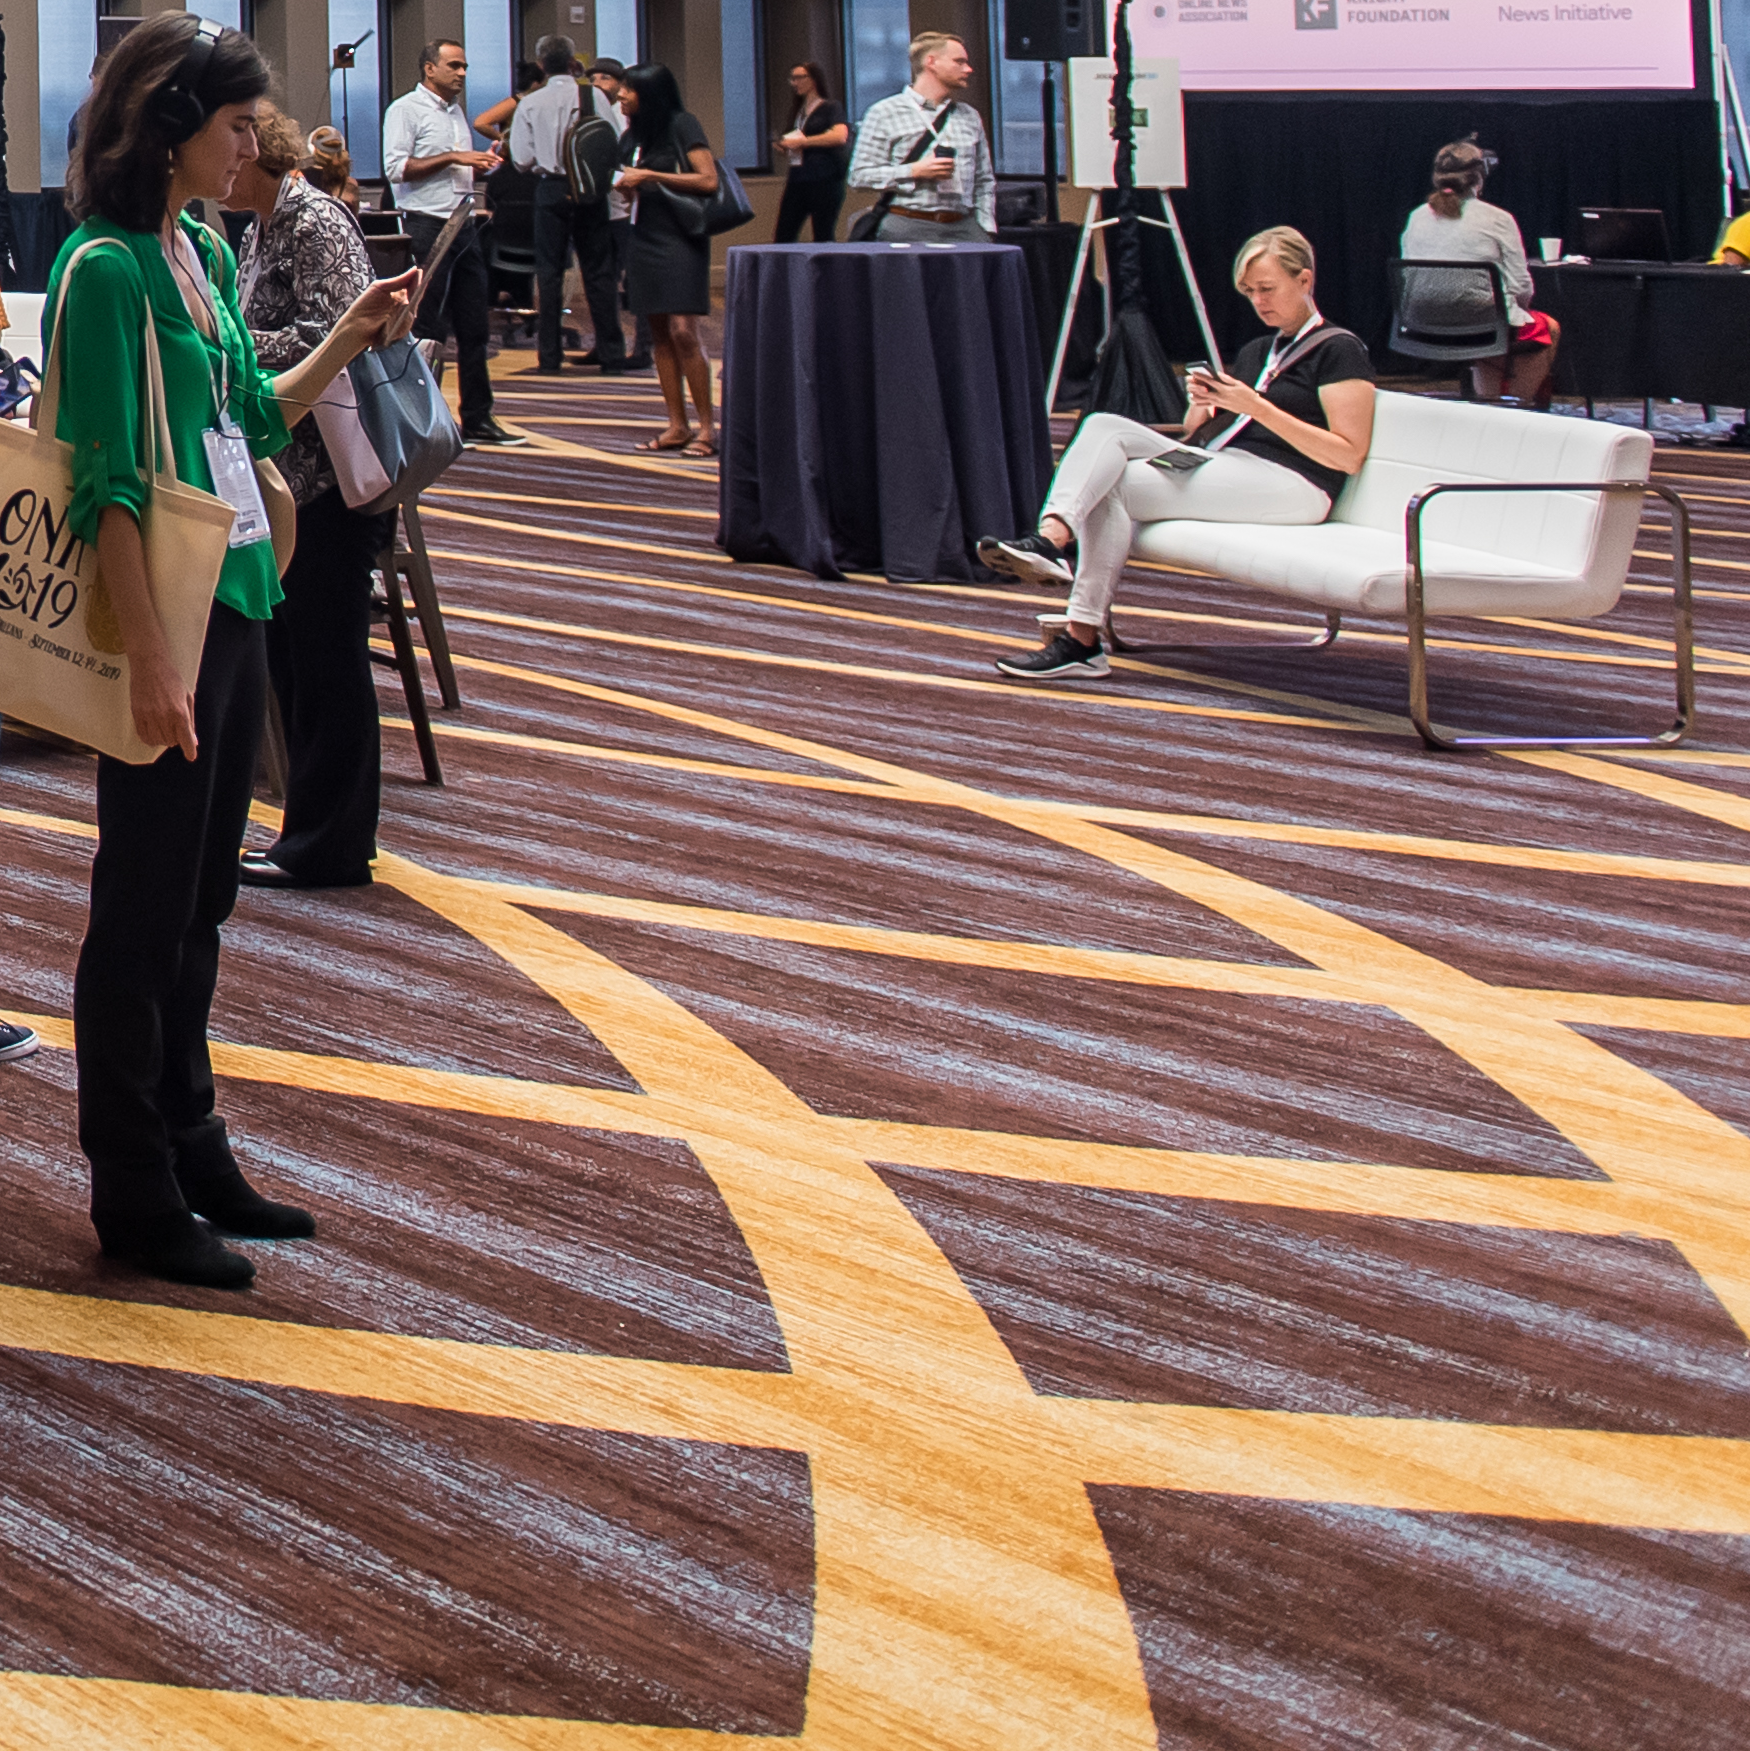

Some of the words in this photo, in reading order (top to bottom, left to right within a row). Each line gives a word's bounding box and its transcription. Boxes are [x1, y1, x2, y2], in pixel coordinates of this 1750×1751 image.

[1347, 8, 1450, 23] FOUNDATION
[1498, 5, 1550, 22] News
[1554, 2, 1633, 22] Initiative
